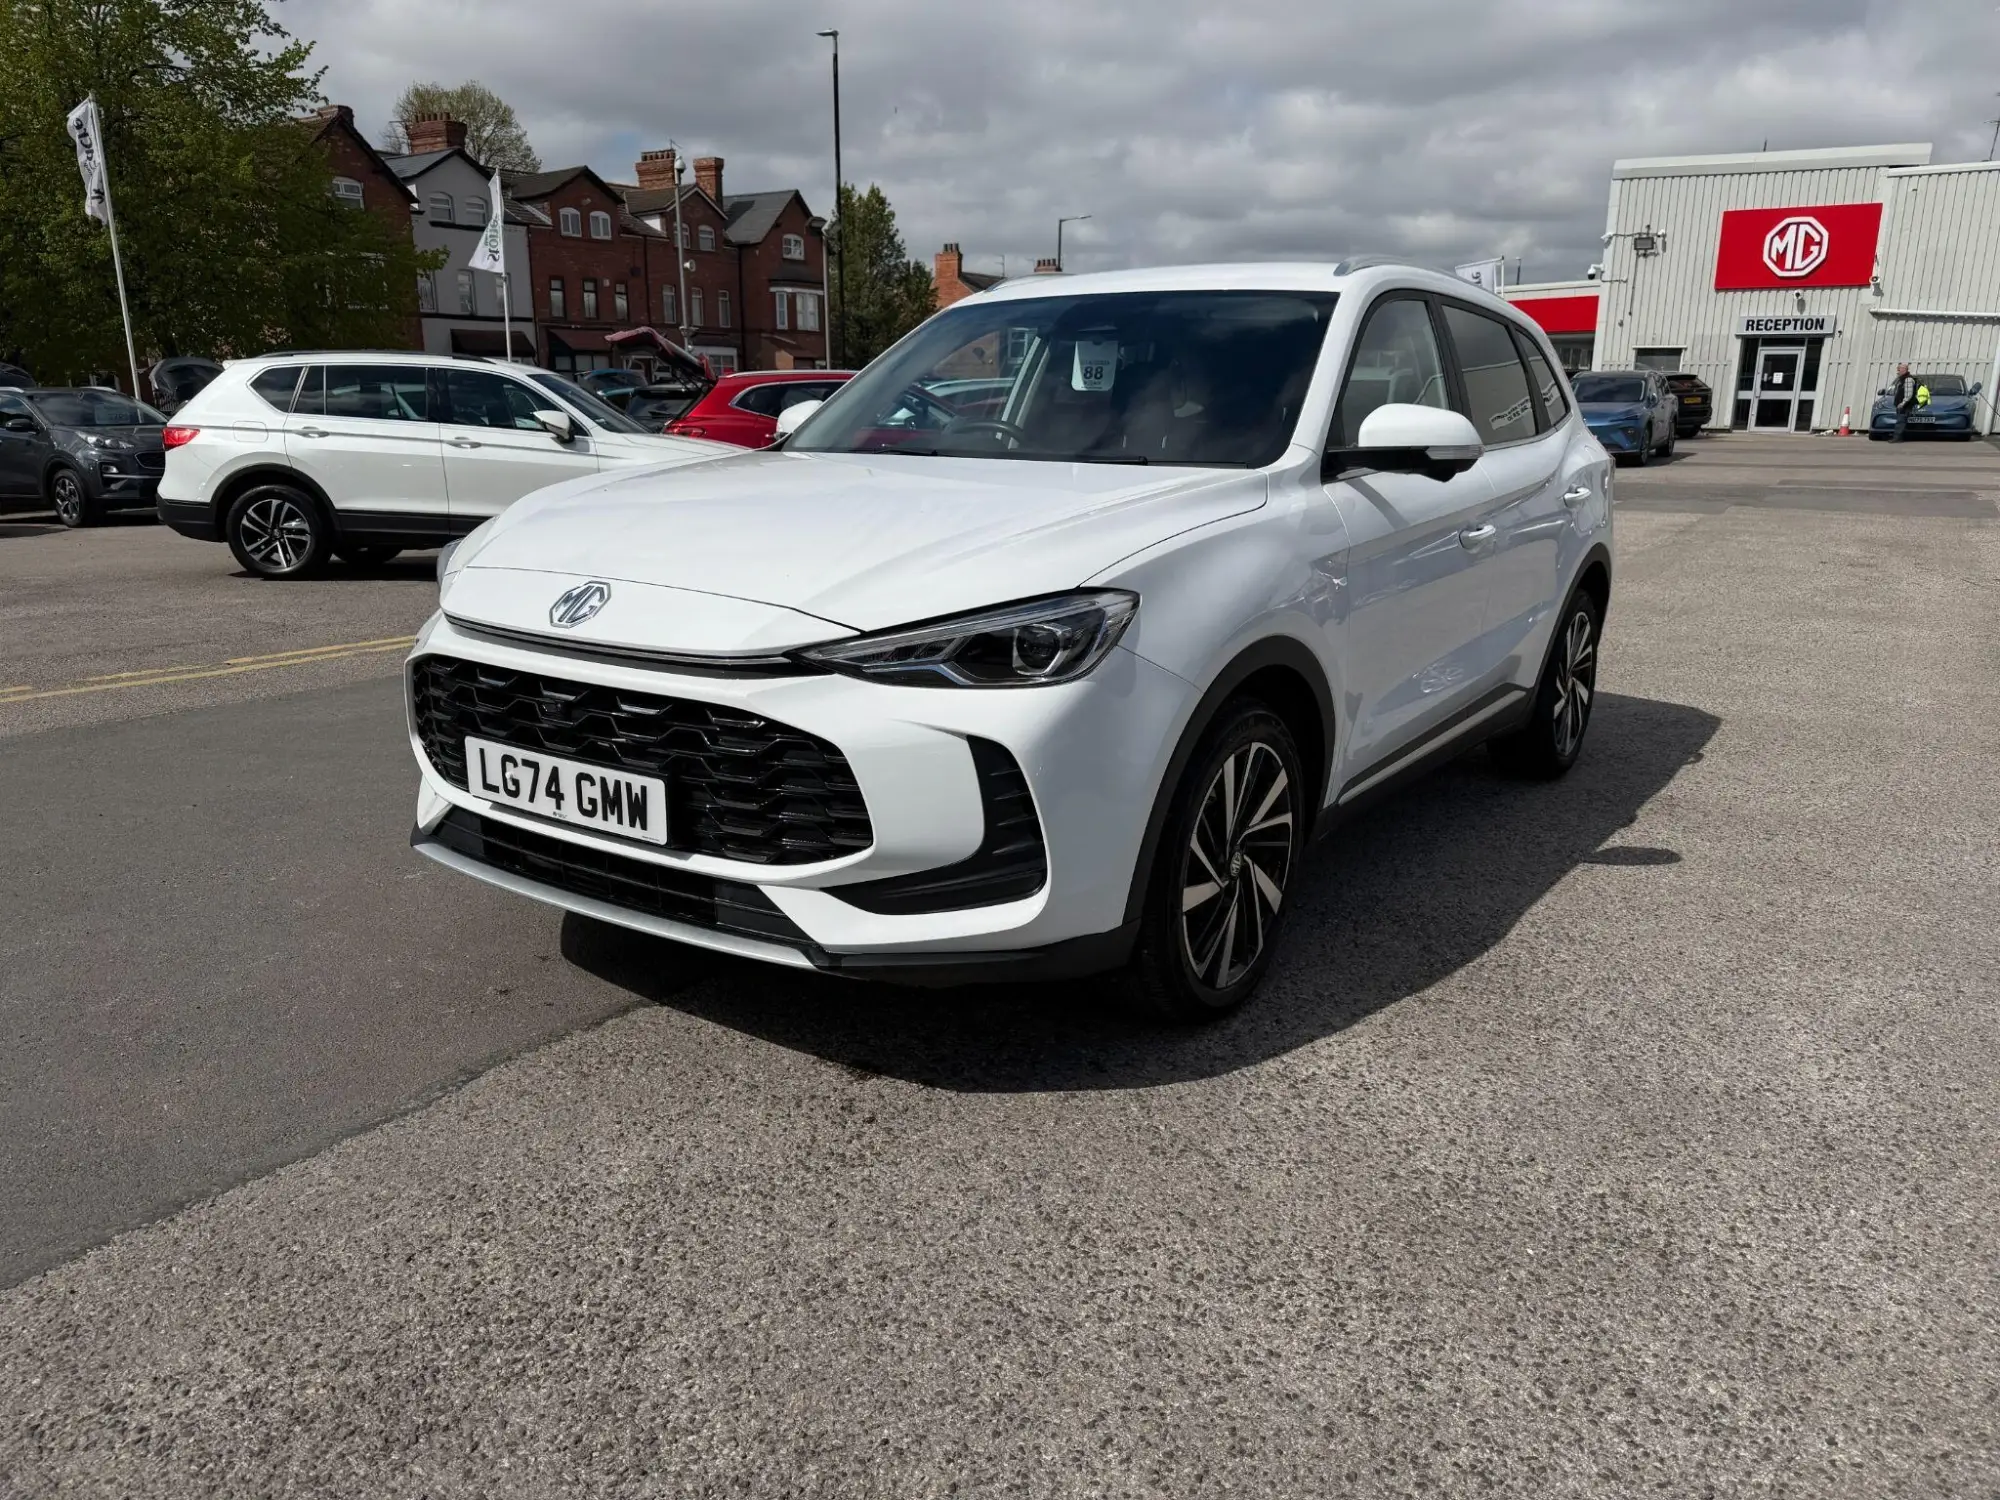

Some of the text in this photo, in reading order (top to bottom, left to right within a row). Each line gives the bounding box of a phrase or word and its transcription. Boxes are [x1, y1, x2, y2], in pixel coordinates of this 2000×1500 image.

[1769, 222, 1823, 271] MG
[1745, 317, 1825, 331] RECEPTION
[1083, 365, 1104, 380] 88
[553, 583, 607, 625] MG
[478, 747, 648, 831] LG74 GMW
